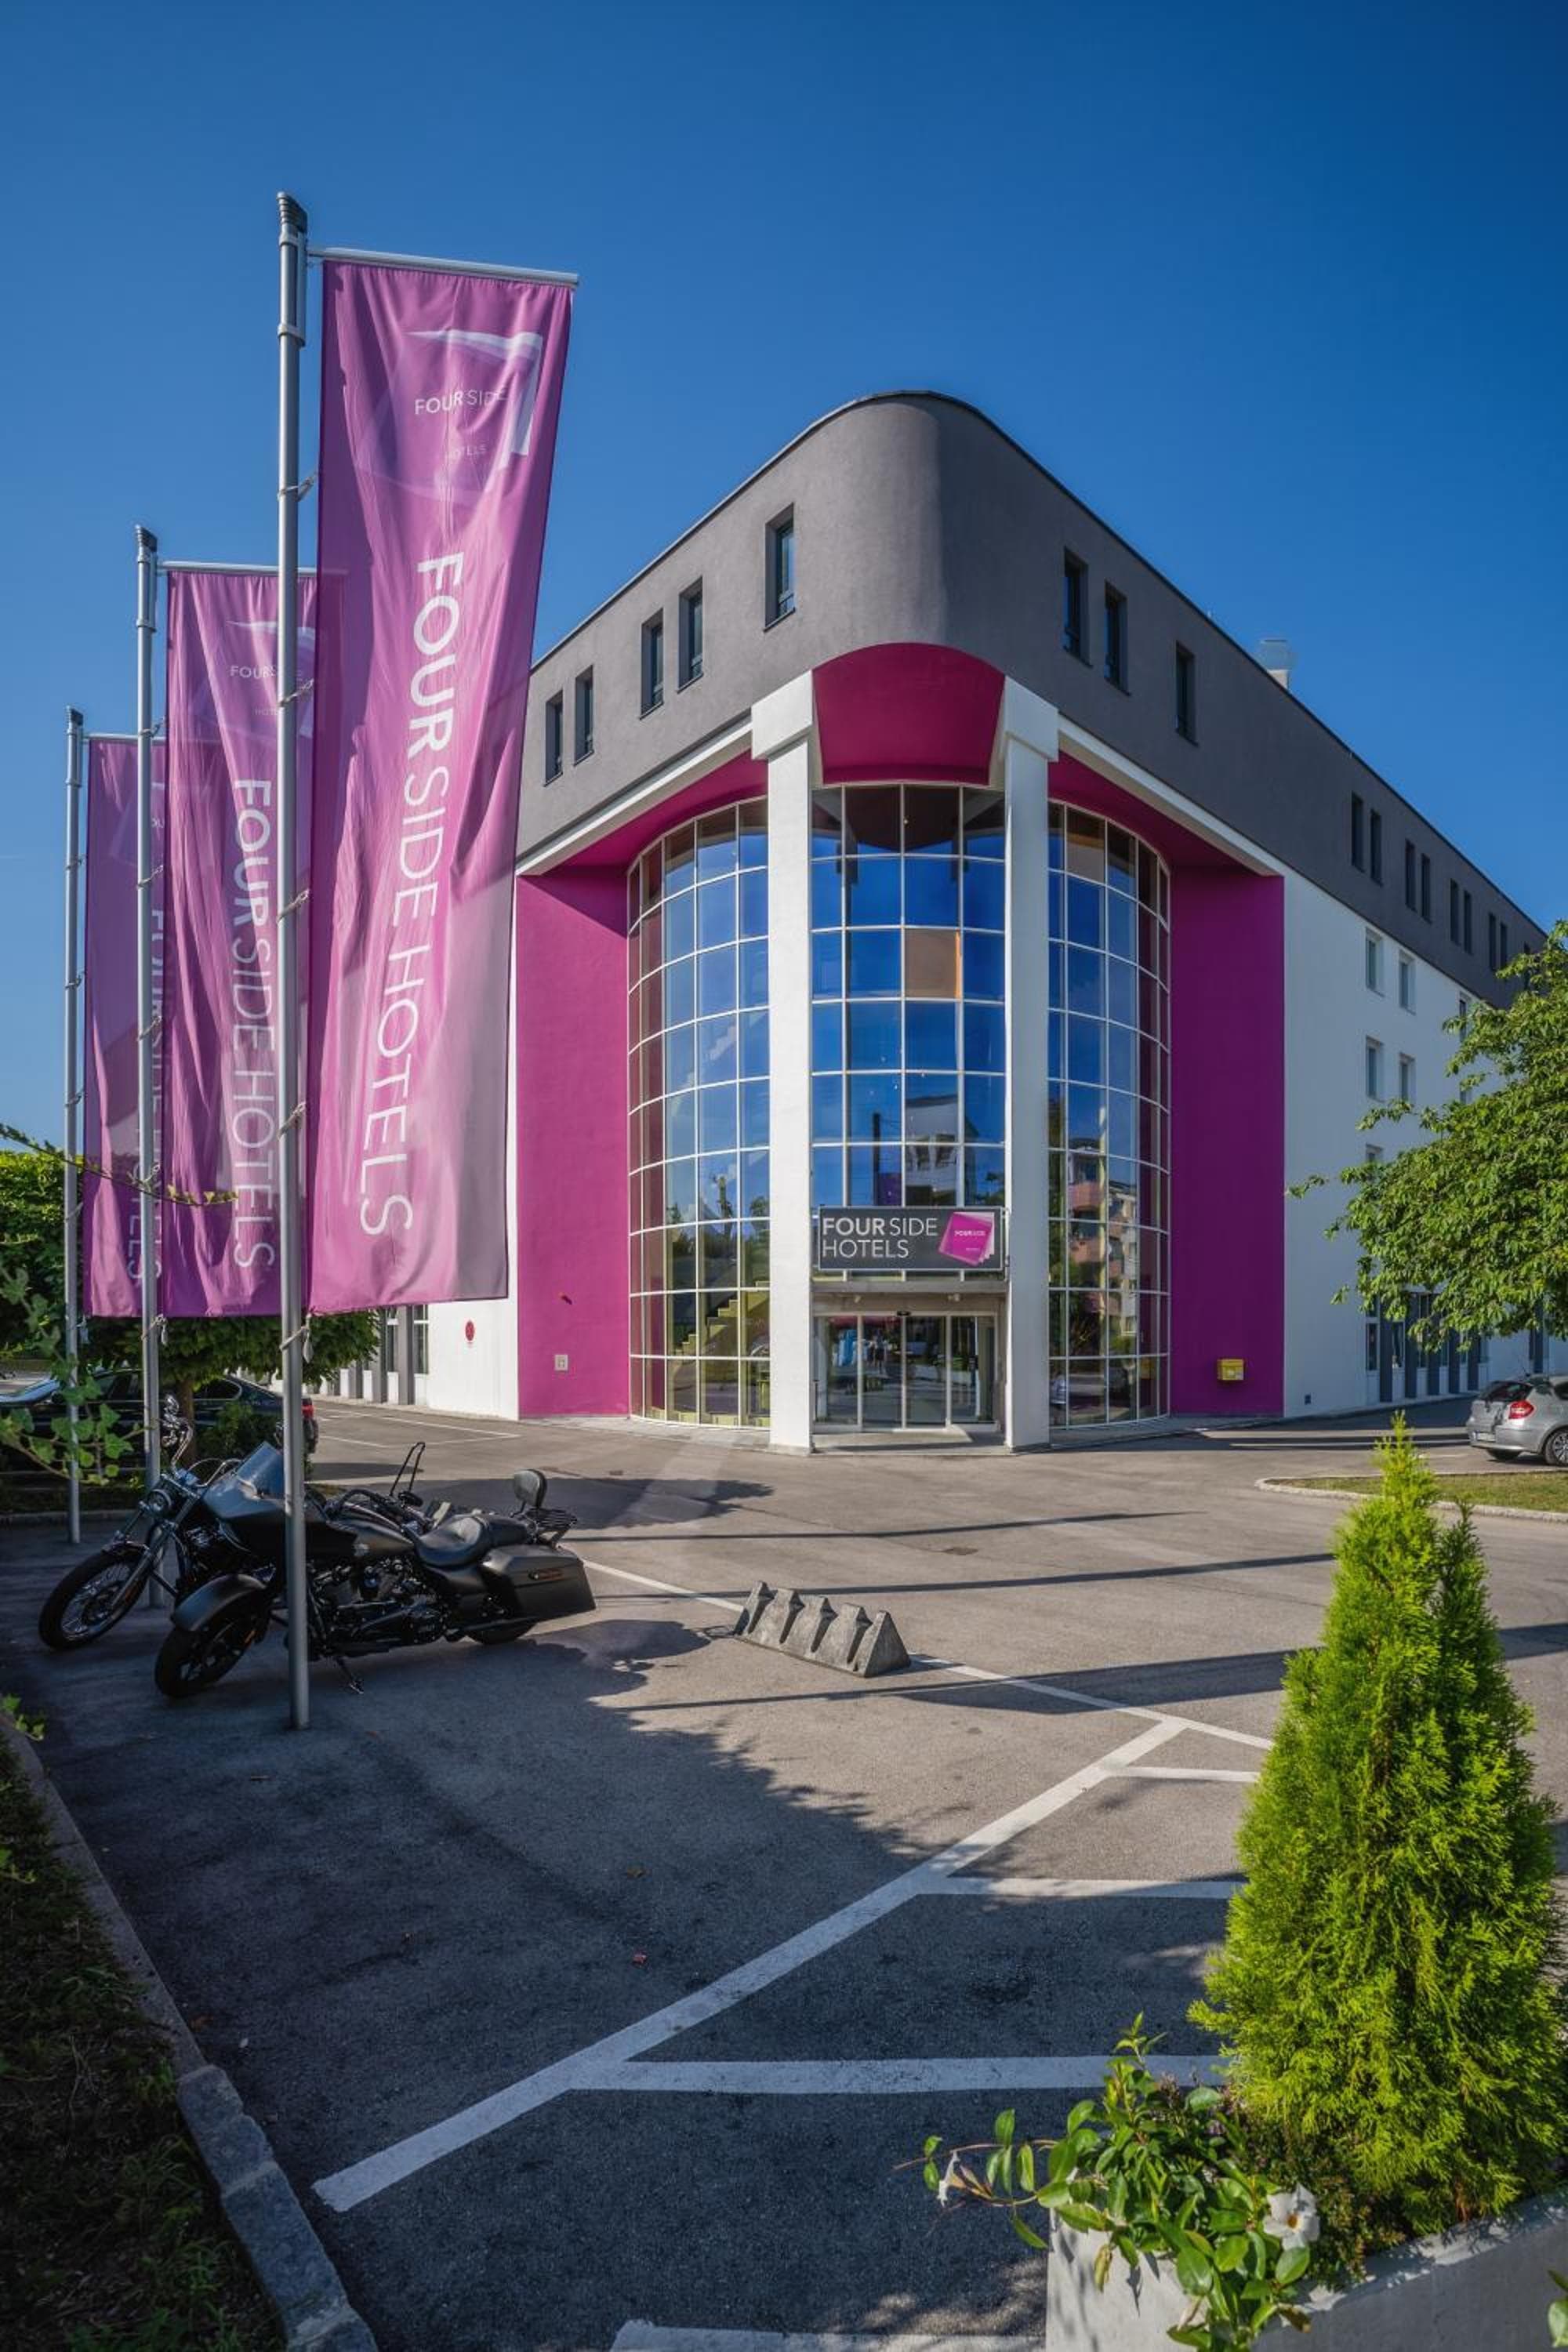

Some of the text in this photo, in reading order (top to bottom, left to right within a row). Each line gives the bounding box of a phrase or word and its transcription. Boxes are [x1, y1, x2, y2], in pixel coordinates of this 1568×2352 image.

[233, 1069, 275, 1268] HOTELS
[360, 944, 431, 1236] HOTELS
[822, 1240, 909, 1258] HOTELS
